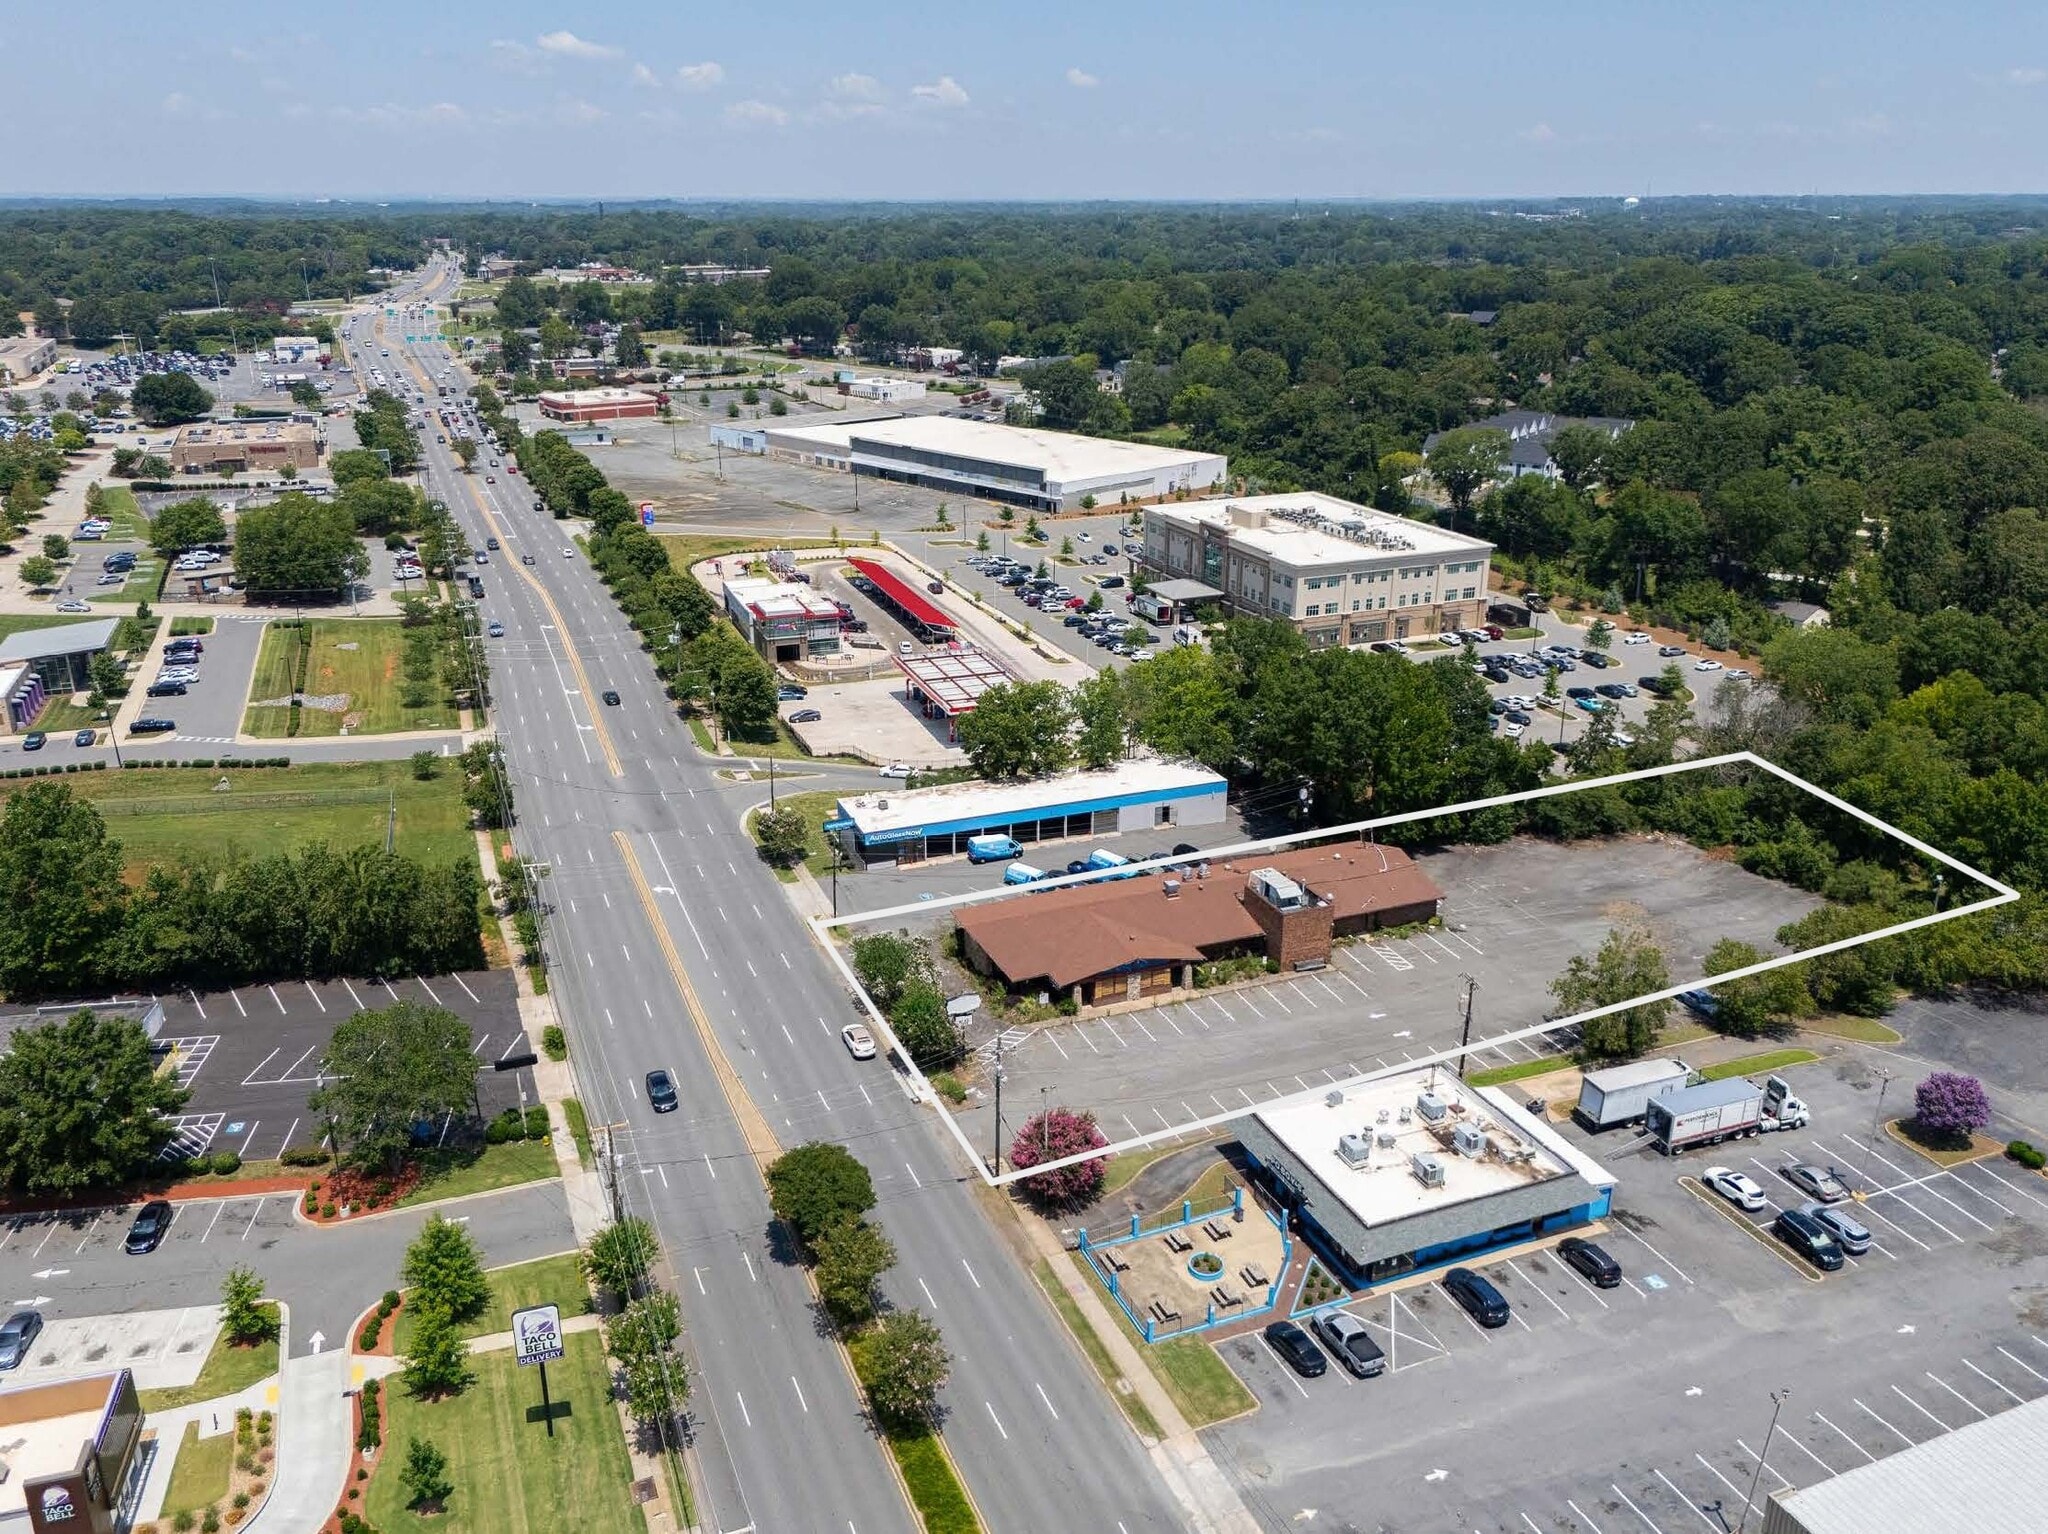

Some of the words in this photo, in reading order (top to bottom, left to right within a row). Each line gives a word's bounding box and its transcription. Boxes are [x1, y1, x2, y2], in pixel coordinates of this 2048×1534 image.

[521, 1332, 556, 1345] TACO
[525, 1341, 557, 1354] BELL
[520, 1350, 561, 1365] DELIVERY
[42, 1504, 74, 1517] TACO
[45, 1511, 75, 1522] BELL
